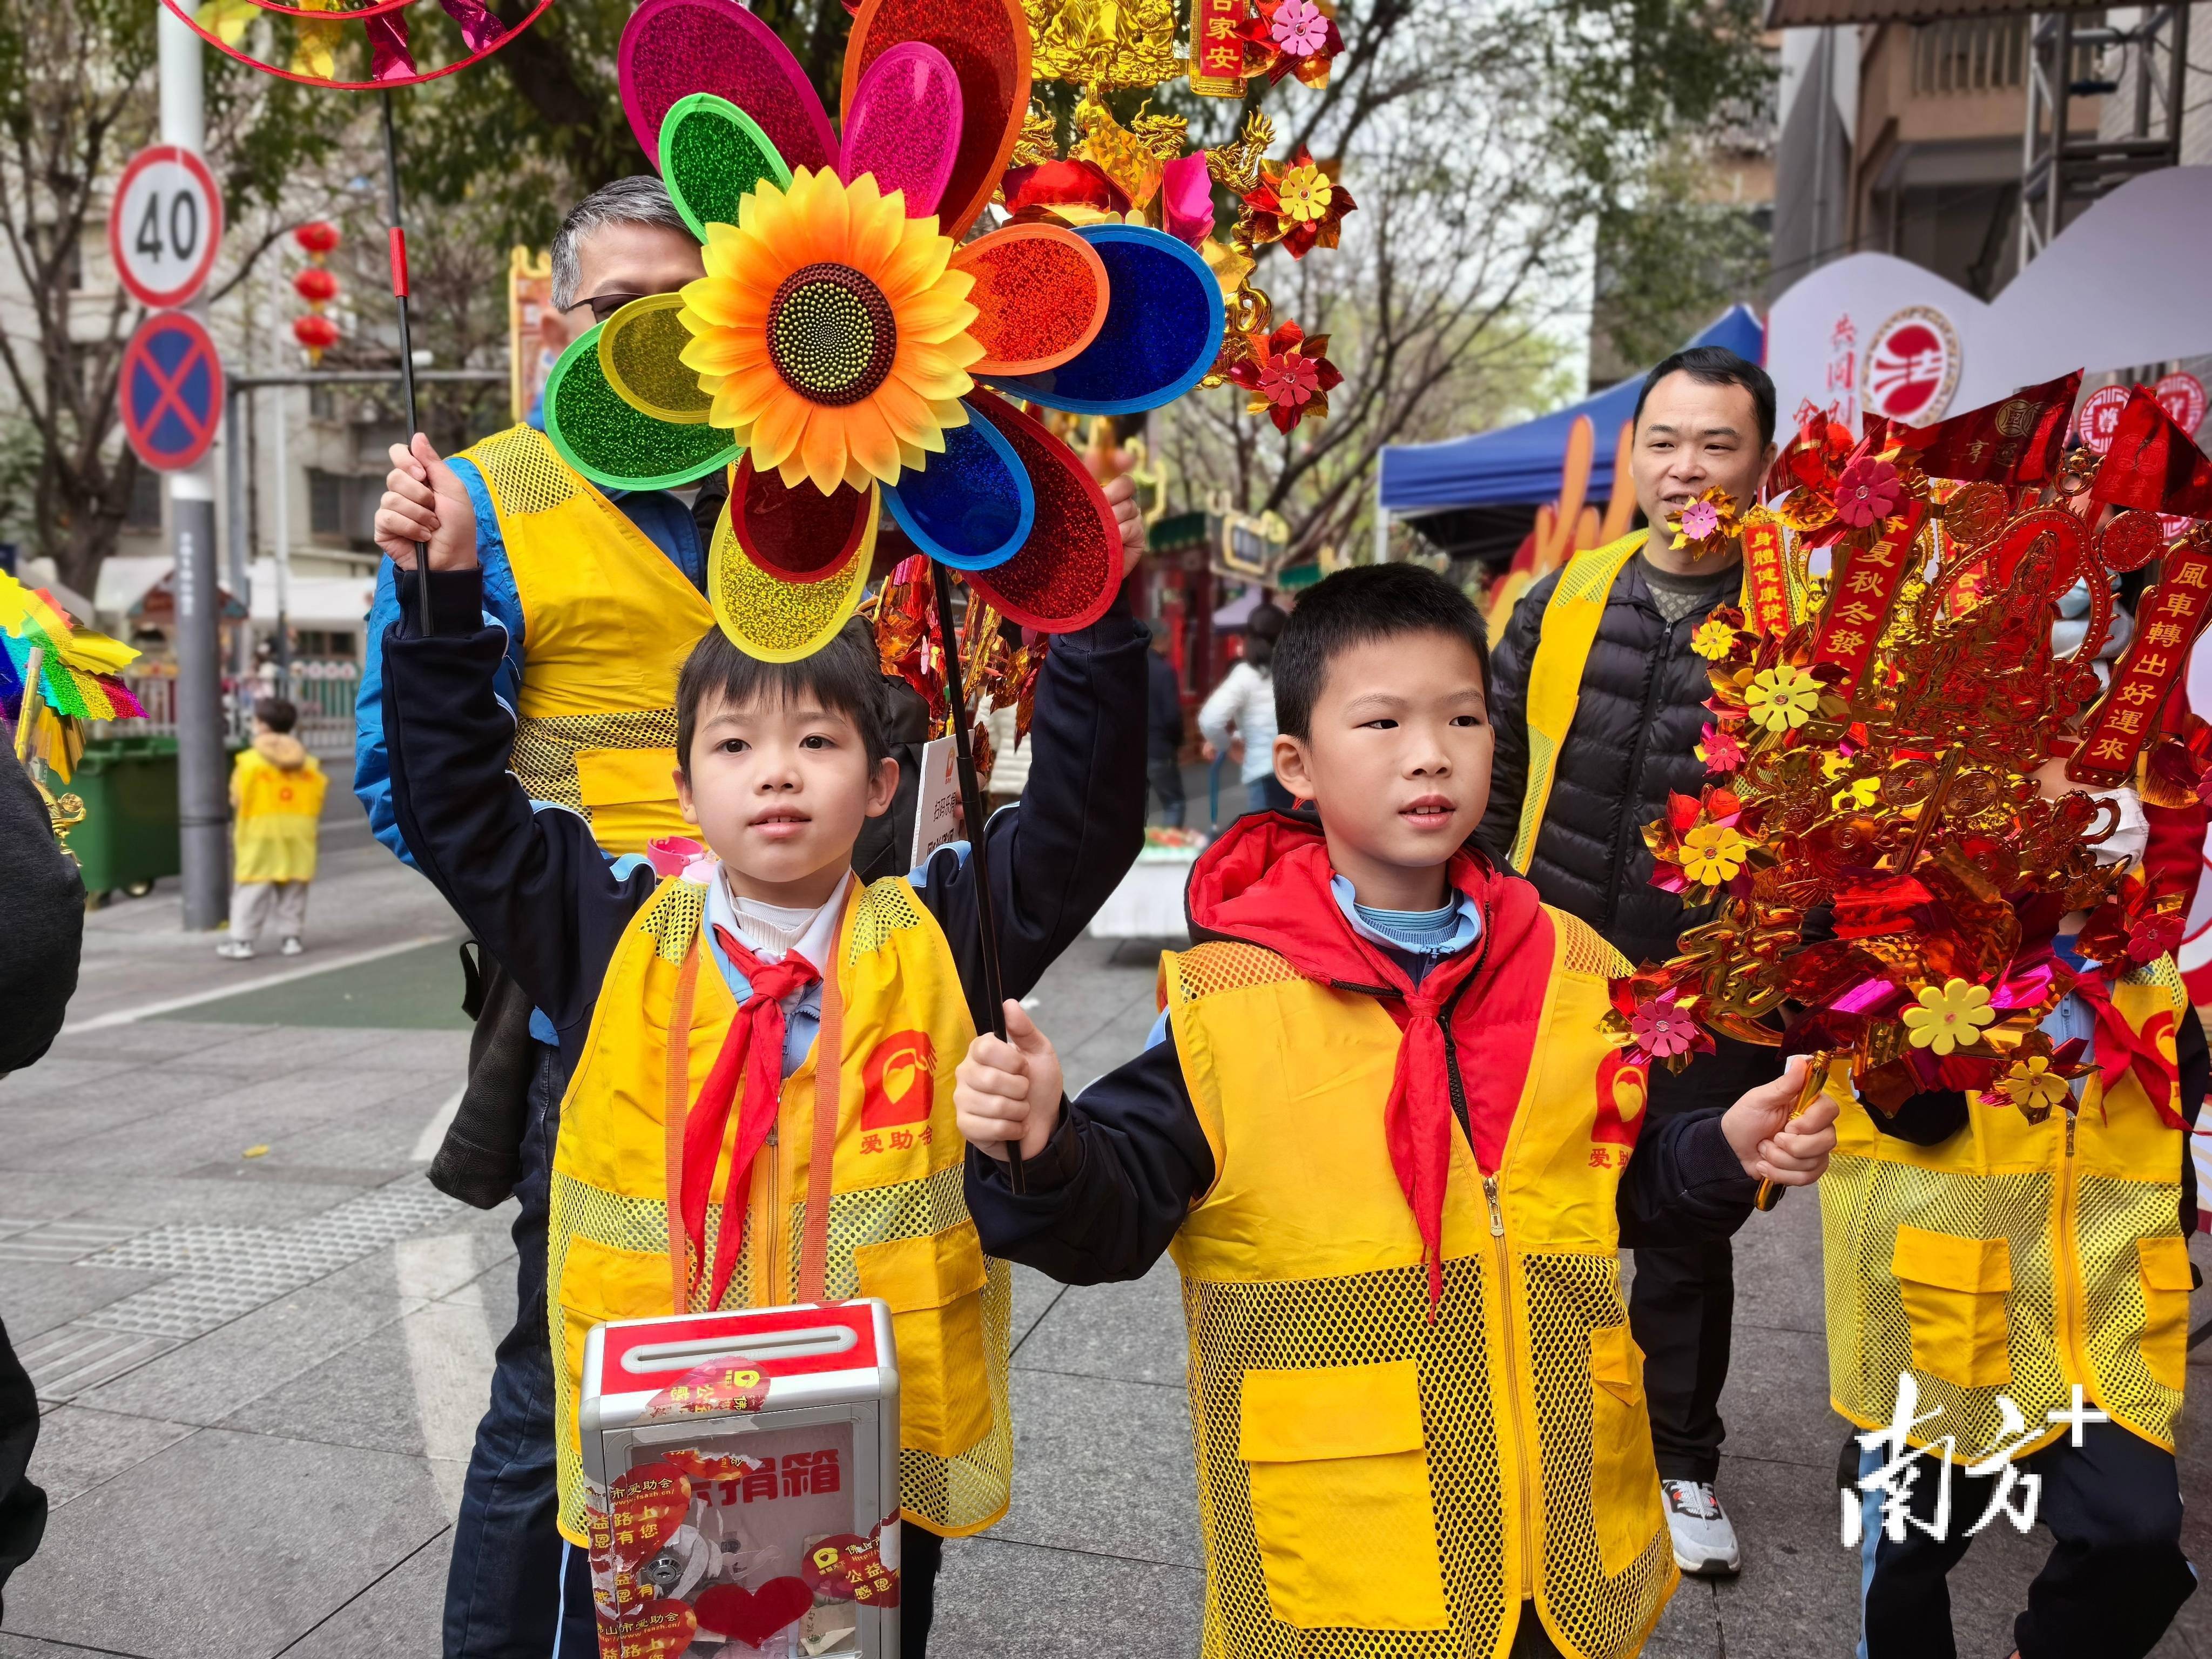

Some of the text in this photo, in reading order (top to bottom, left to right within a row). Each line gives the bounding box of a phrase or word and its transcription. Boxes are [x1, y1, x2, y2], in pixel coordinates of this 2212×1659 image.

[136, 191, 197, 263] 40
[2091, 561, 2208, 760] 風車轉出好運來
[859, 1124, 933, 1155] 爱助会
[595, 1524, 658, 1549] 恩有您
[854, 1578, 892, 1600] 感恩
